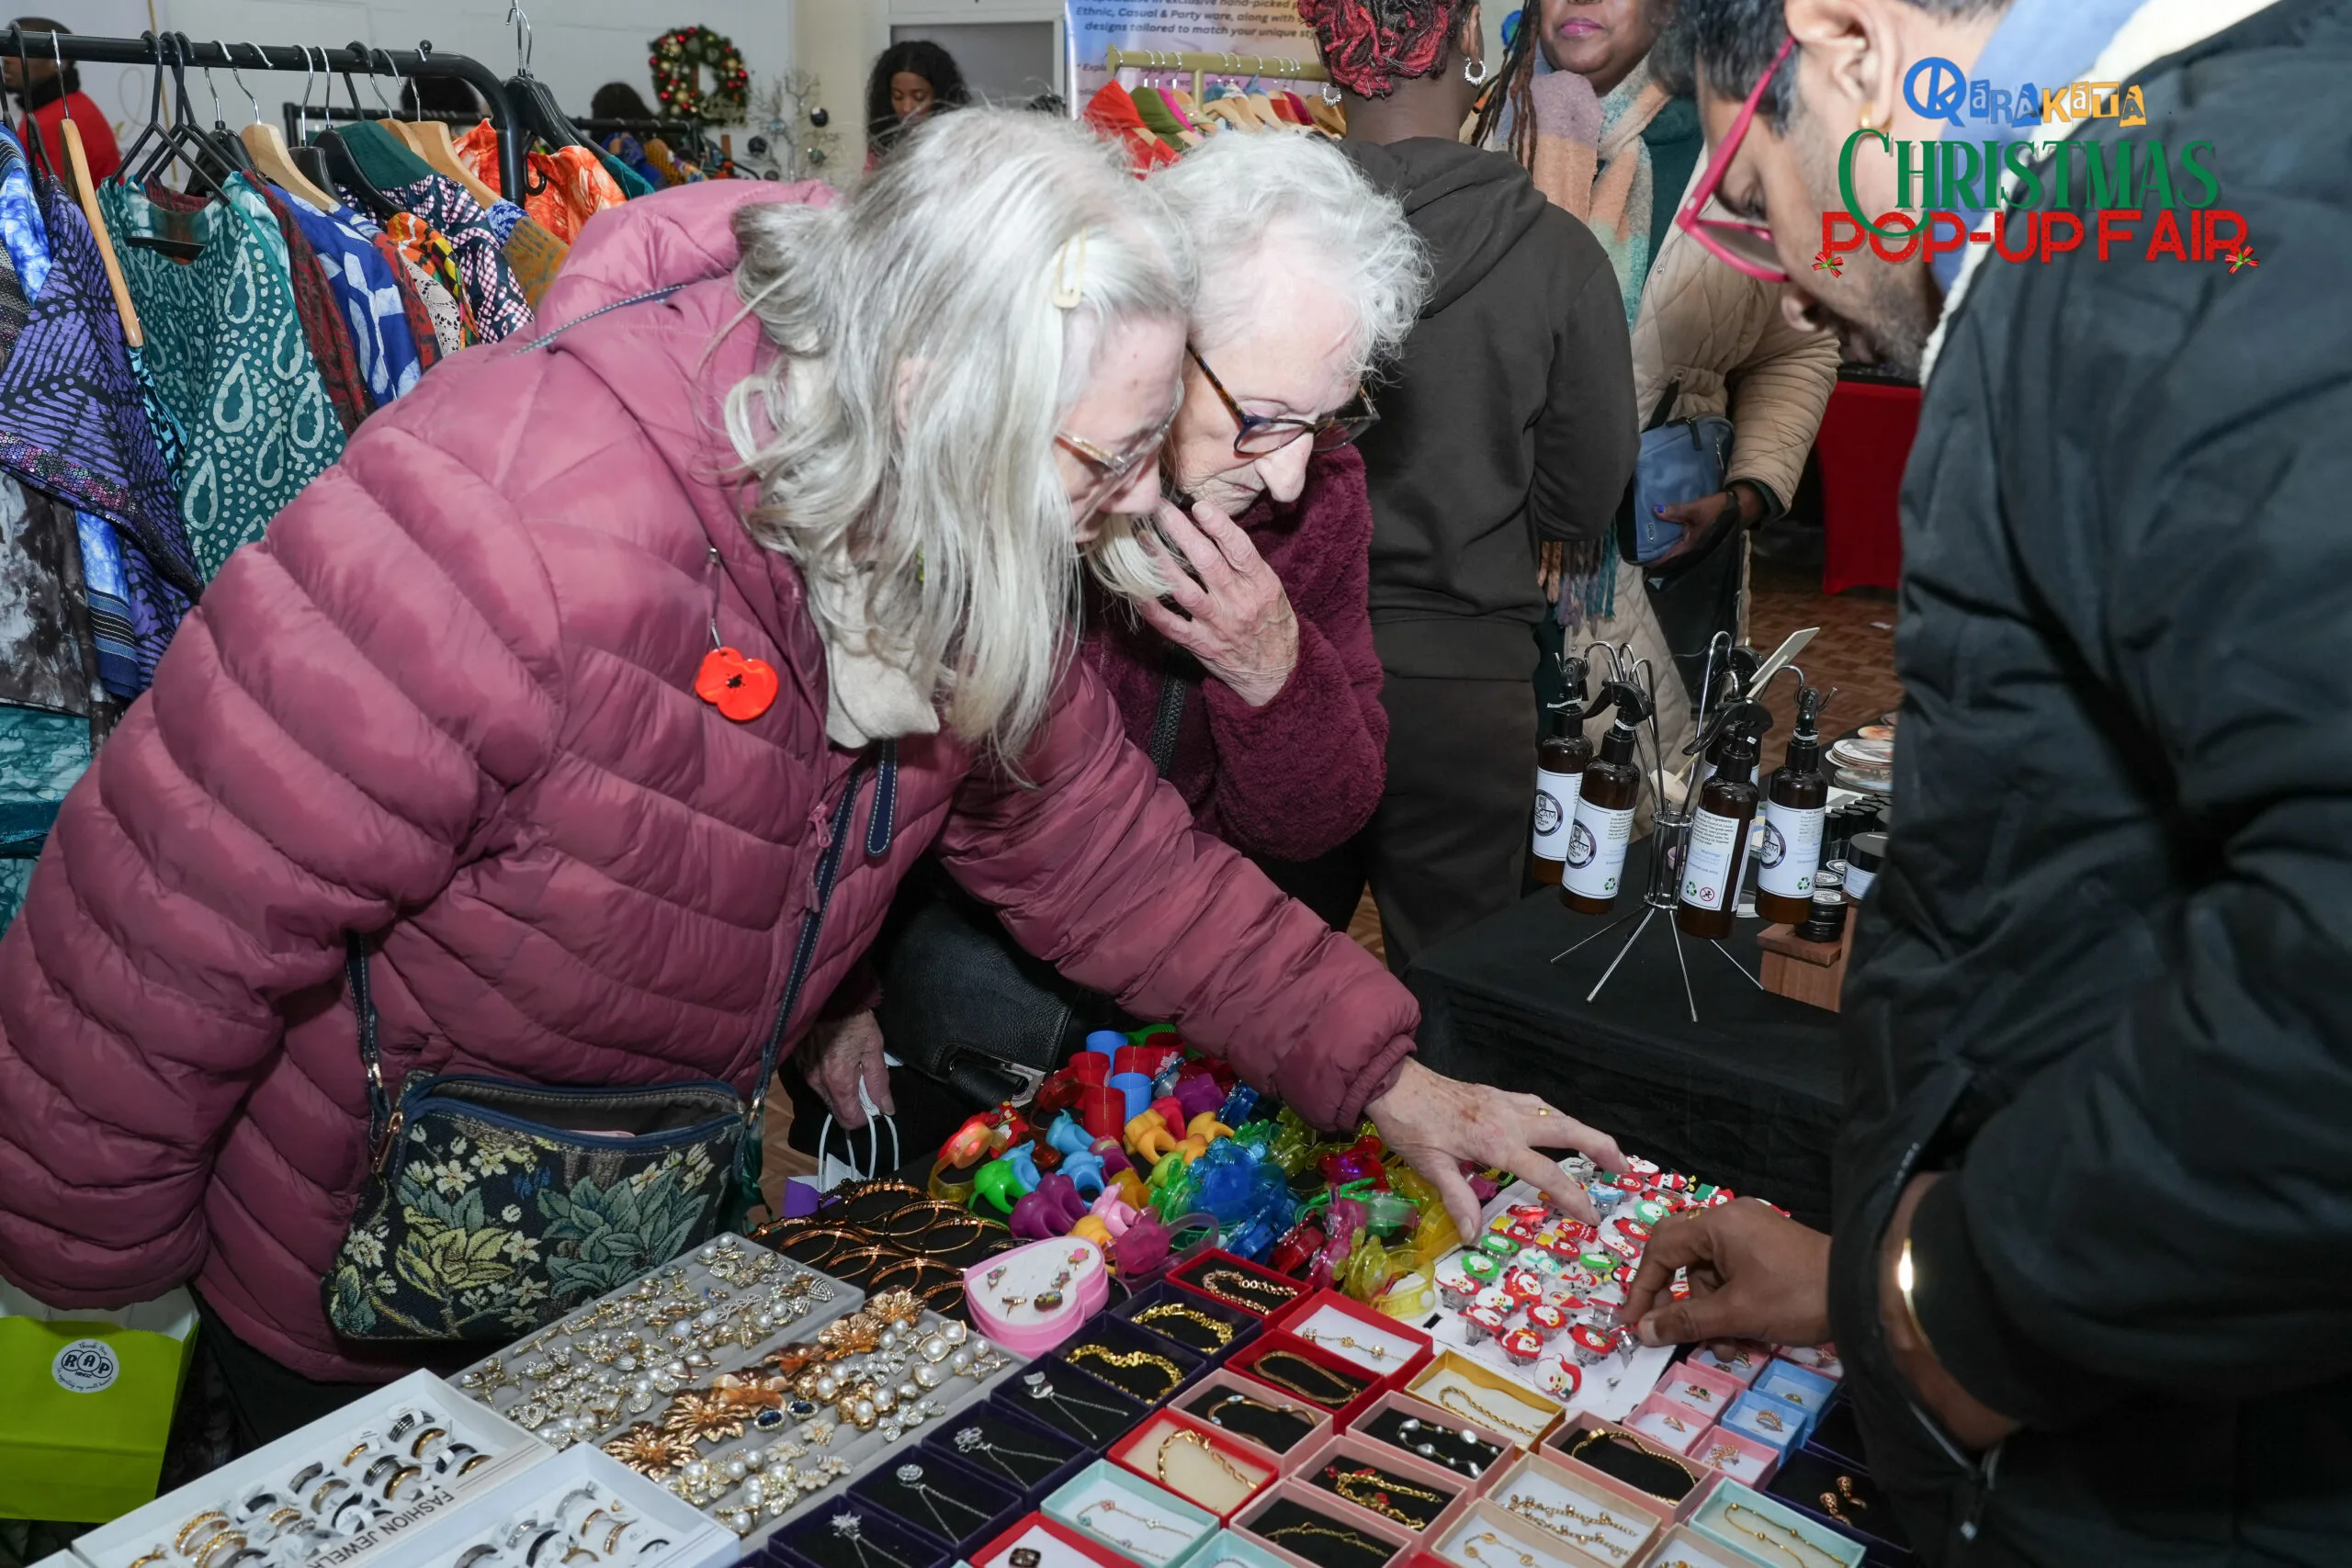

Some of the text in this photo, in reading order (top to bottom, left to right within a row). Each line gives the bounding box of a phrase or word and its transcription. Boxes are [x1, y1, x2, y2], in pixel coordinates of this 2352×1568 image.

[1076, 6, 1115, 17] Ethnic,
[1118, 7, 1158, 17] Casual
[1159, 9, 1169, 18] &
[1170, 9, 1203, 21] Party
[1237, 13, 1269, 23] along
[1272, 15, 1295, 23] with
[1084, 22, 1127, 33] designs
[1129, 22, 1175, 33] tailored
[1177, 25, 1190, 33] to
[1192, 26, 1228, 35] match
[1230, 28, 1258, 38] your
[1259, 28, 1296, 39] unique
[379, 1490, 456, 1536] FASHION
